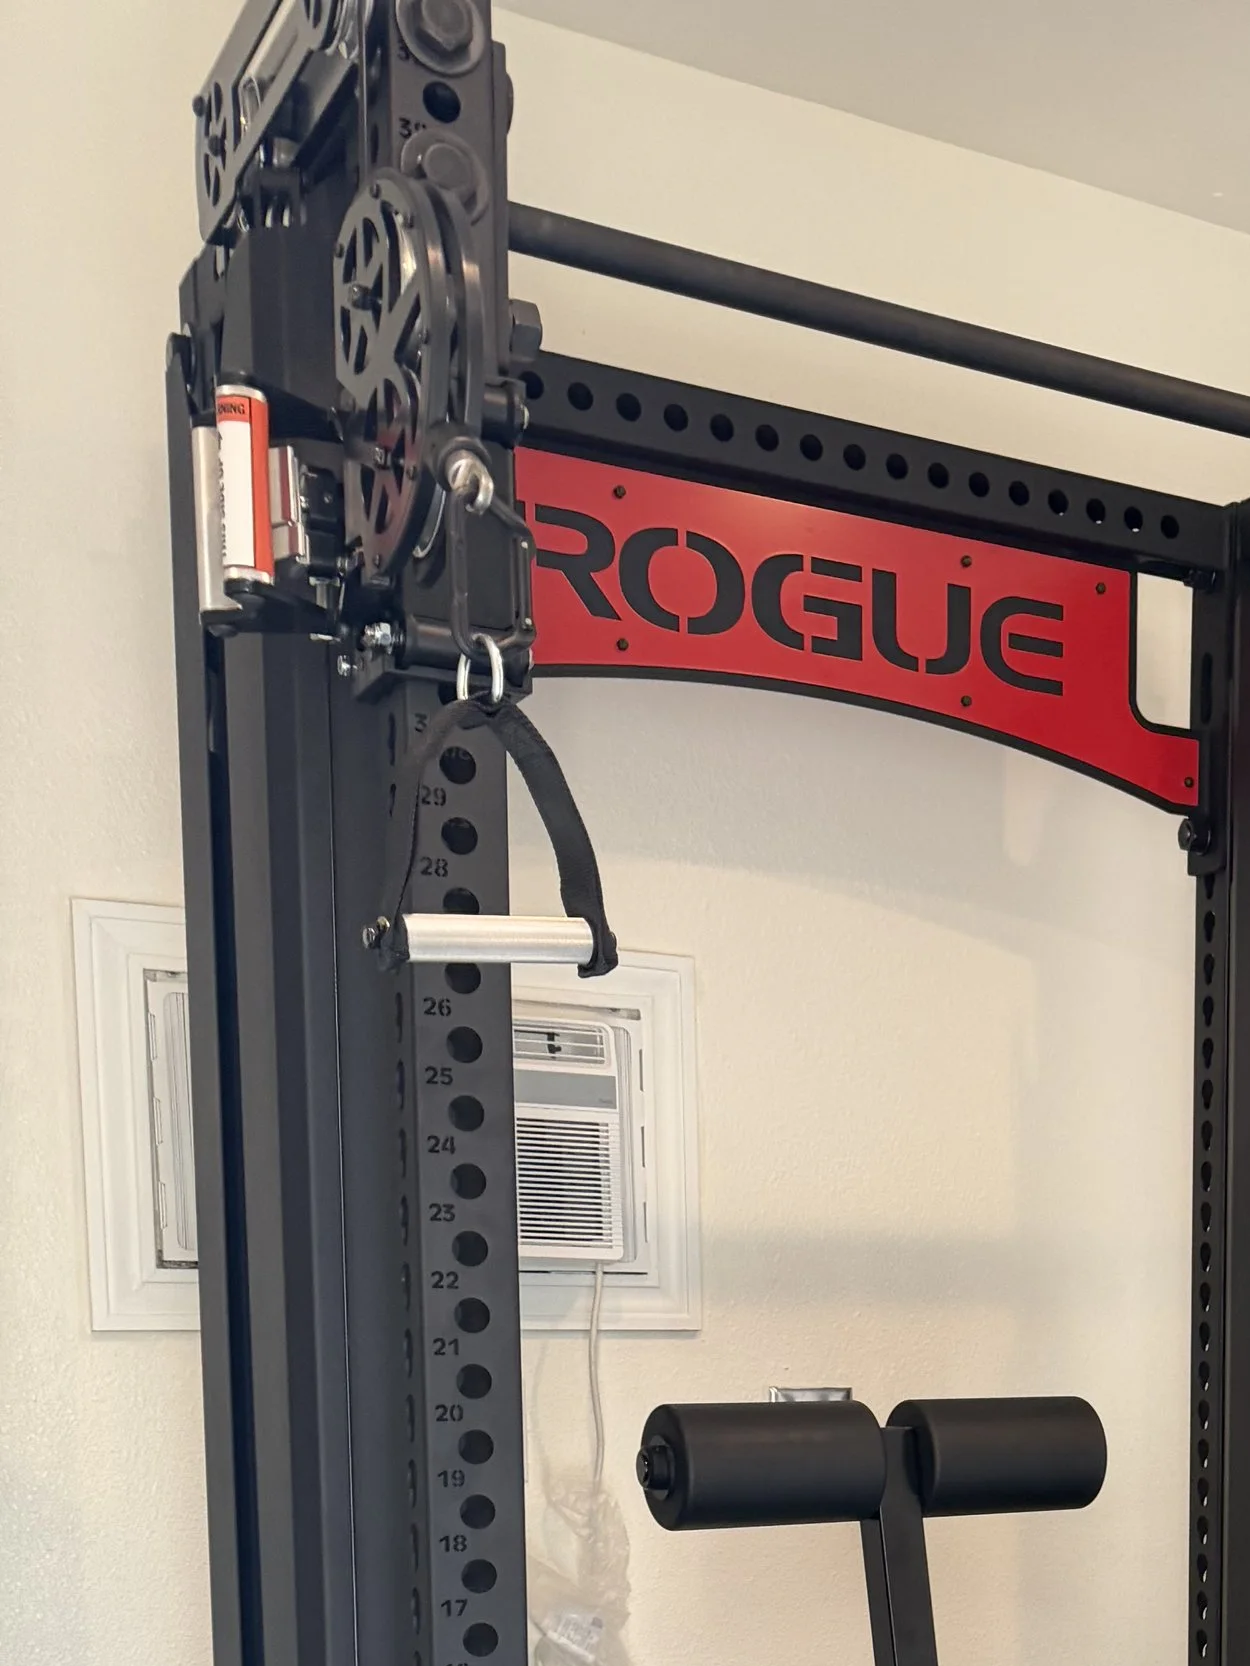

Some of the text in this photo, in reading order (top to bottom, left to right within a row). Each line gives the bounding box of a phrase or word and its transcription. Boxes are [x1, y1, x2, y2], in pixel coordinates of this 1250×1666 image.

[513, 500, 1064, 697] ROGUE
[414, 712, 428, 733] 3
[421, 785, 446, 806] 29
[420, 857, 449, 877] 28
[423, 997, 452, 1016] 26
[425, 1066, 453, 1085] 25
[427, 1135, 455, 1154] 24
[429, 1204, 455, 1222] 23
[431, 1271, 459, 1289] 22
[432, 1338, 459, 1355] 21
[435, 1404, 463, 1422] 20
[437, 1470, 465, 1487] 19
[439, 1535, 467, 1552] 18
[441, 1599, 468, 1617] 17
